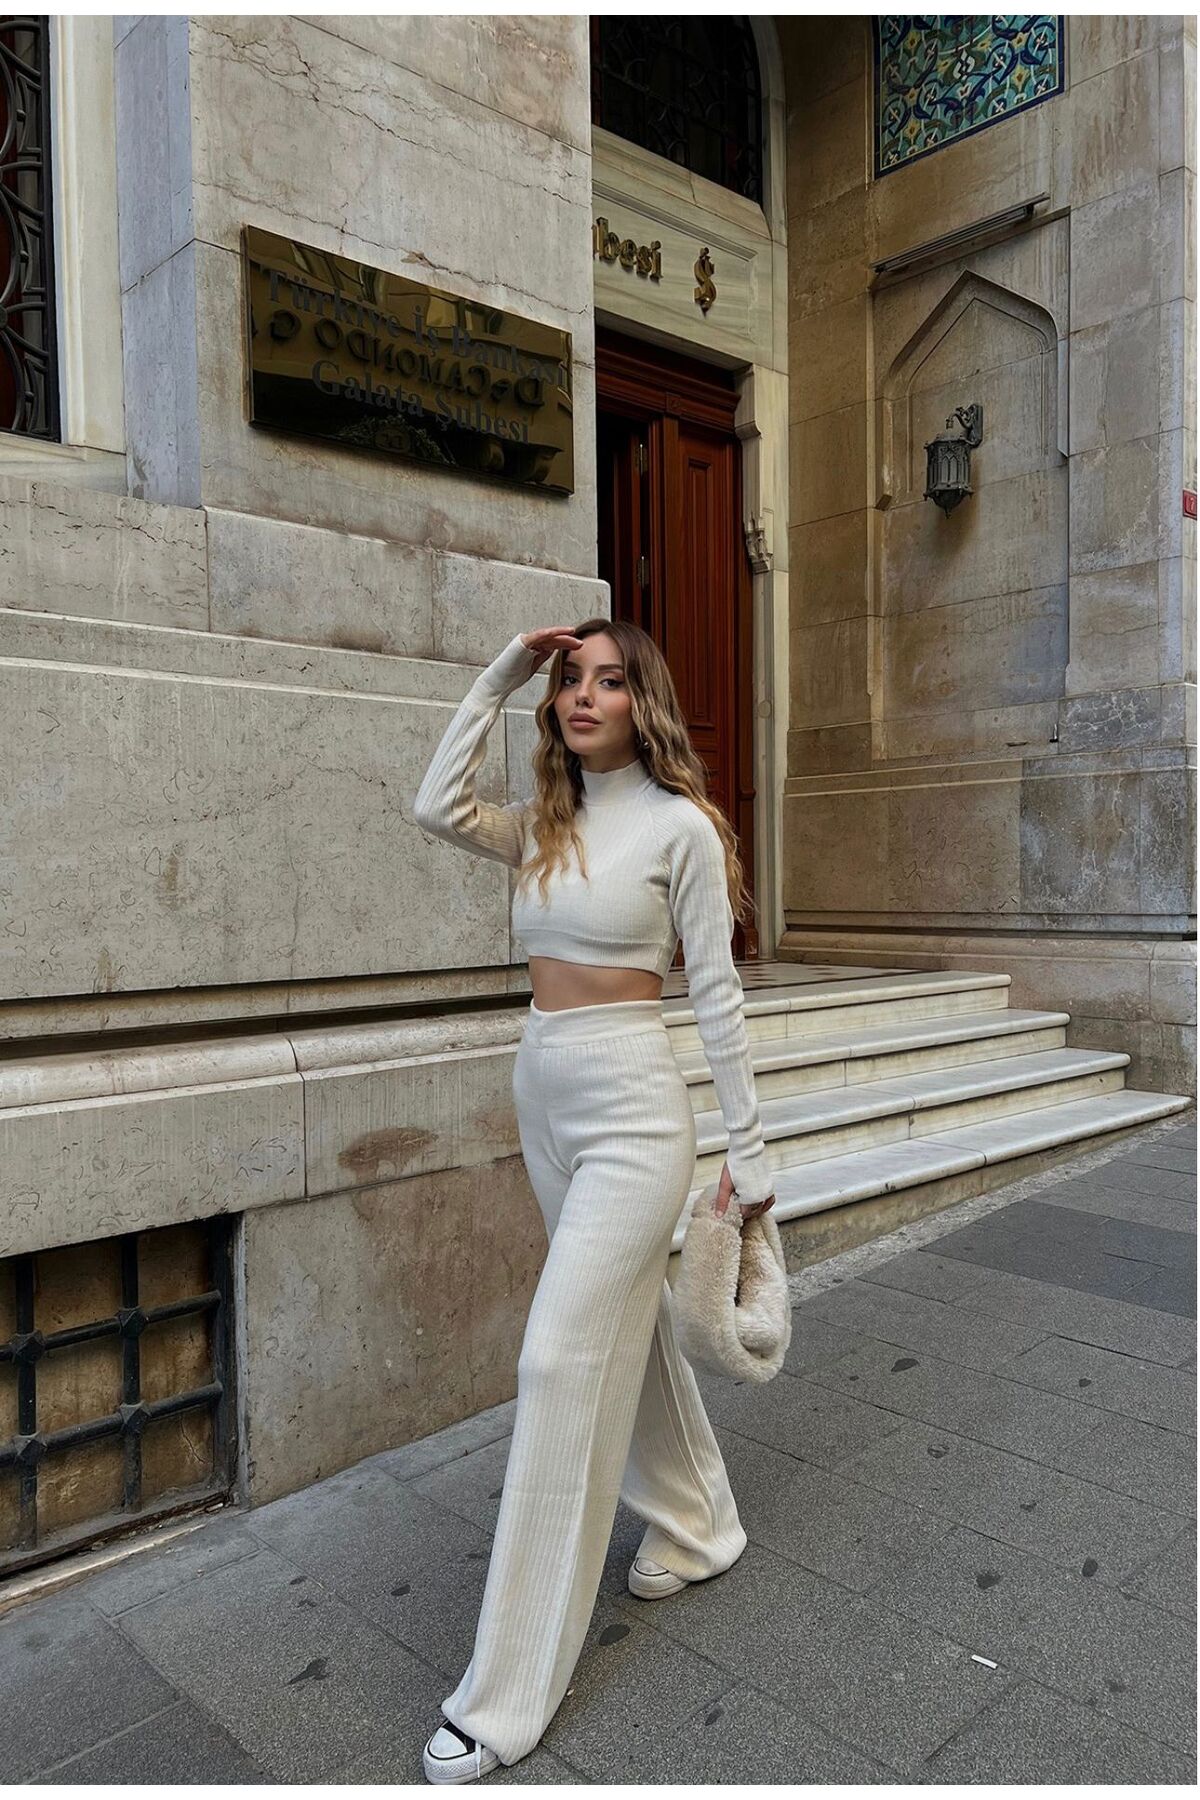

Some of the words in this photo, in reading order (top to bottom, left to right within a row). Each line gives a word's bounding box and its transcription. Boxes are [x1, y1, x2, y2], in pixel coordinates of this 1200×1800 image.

[264, 269, 400, 339] Türkiye
[451, 326, 567, 386] Bankası
[312, 360, 424, 417] Galata
[435, 395, 529, 443] Şubesi
